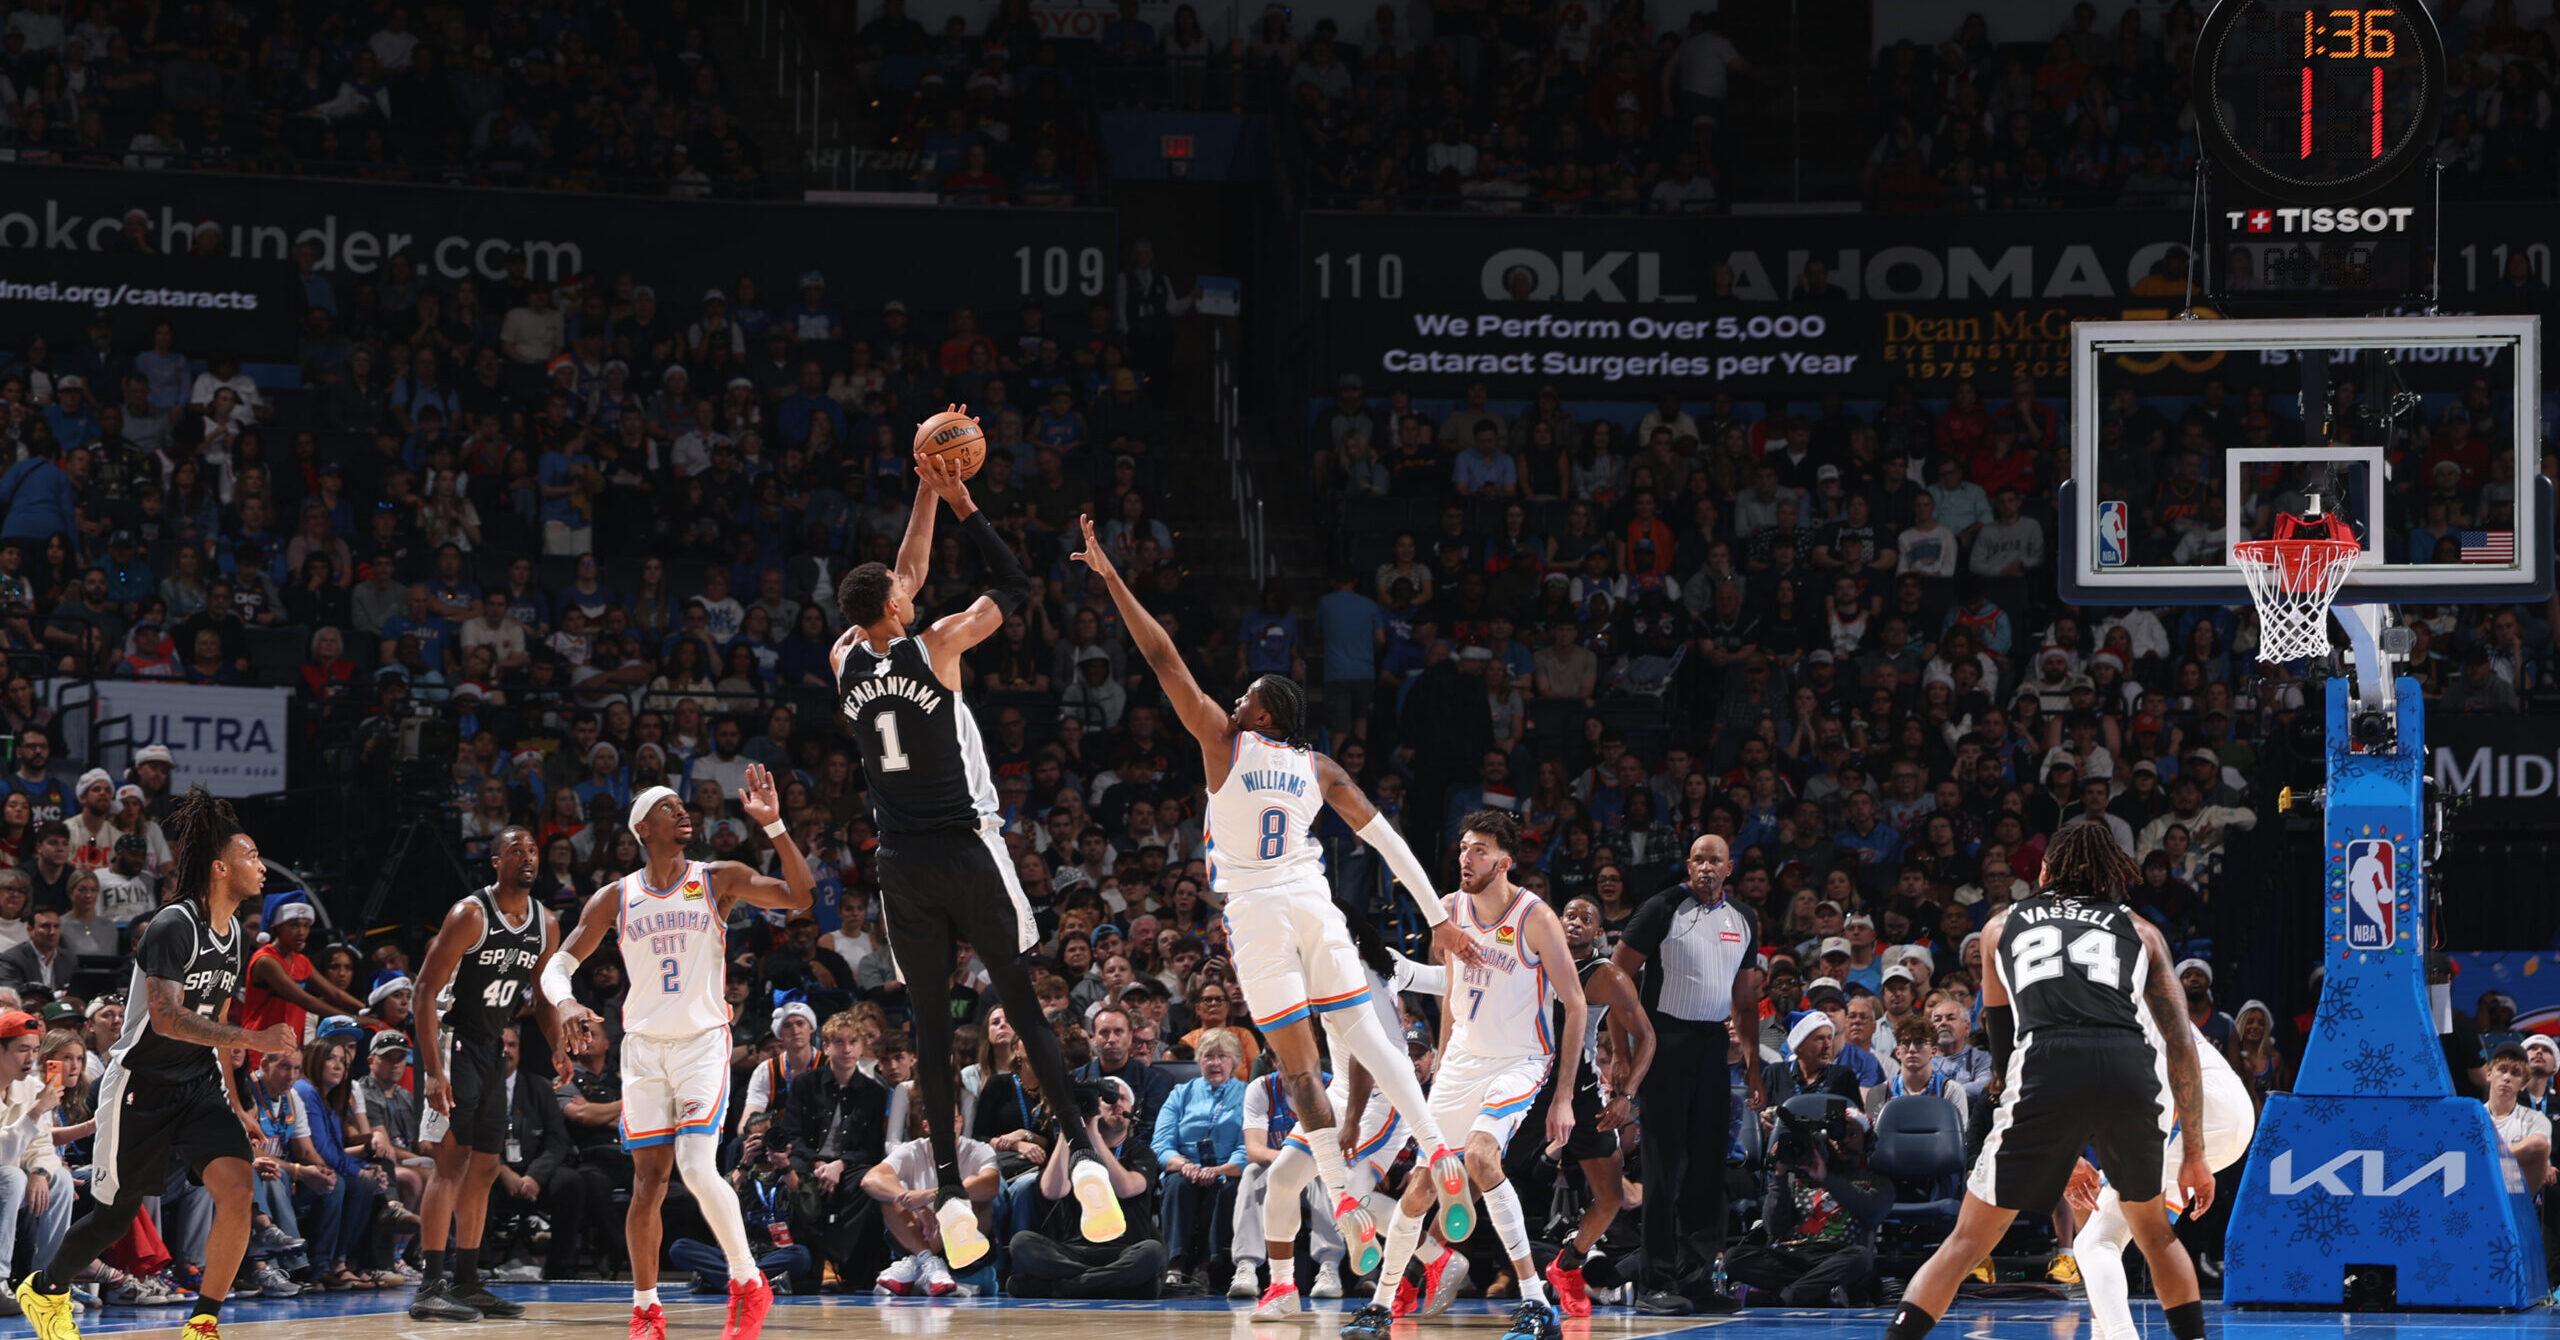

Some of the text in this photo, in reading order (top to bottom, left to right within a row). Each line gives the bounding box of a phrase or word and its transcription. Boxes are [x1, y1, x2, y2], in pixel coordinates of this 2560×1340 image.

[2304, 9, 2396, 59] 1:36
[2301, 66, 2383, 158] 11
[2276, 207, 2415, 233] TISSOT
[1015, 245, 1104, 297] 109
[1314, 252, 1403, 300] 110
[1414, 313, 1826, 342] We Perform Over 5,000
[1885, 309, 2110, 342] Dean McG
[1383, 349, 1859, 381] Cataract Surgeries per Year
[1884, 343, 1935, 360] EYE
[1906, 361, 1975, 379] 1975
[2102, 551, 2117, 562] NBA
[843, 675, 941, 721] WEMBANYAMA
[130, 715, 276, 754] ULTRA
[873, 710, 910, 773] 1
[1241, 770, 1306, 798] WILLIAMS
[2434, 746, 2560, 798] MID
[1257, 806, 1289, 861] 8
[626, 910, 712, 943] OKLAHOMA
[2019, 905, 2115, 931] VASSELL
[2353, 925, 2377, 943] NBA
[478, 948, 539, 972] SPURS
[652, 933, 687, 956] CITY
[2011, 925, 2120, 994] 24
[660, 956, 681, 994] 2
[482, 979, 519, 1008] 40
[1468, 986, 1486, 1022] 7
[2270, 1148, 2466, 1198] KIA
